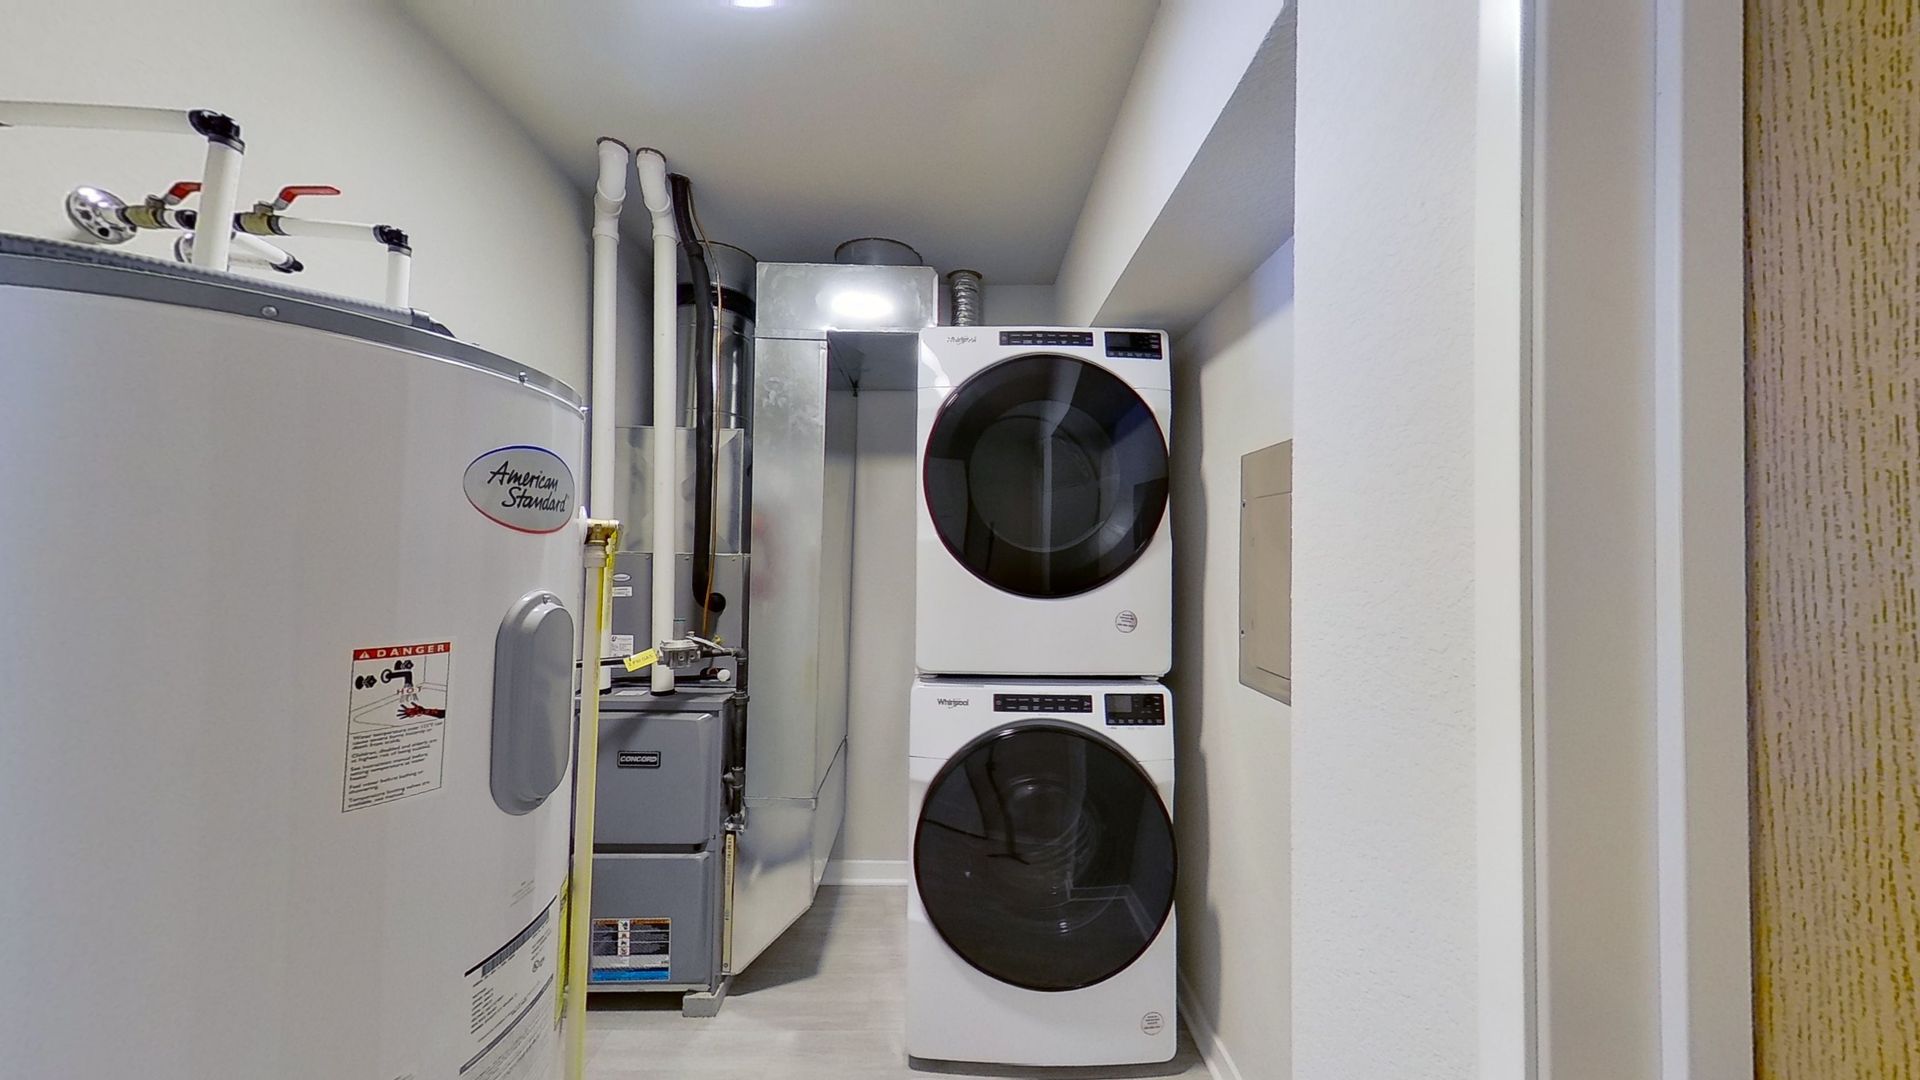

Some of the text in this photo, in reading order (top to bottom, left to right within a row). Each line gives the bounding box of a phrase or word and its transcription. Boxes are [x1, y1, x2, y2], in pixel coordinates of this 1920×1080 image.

[487, 460, 558, 491] American
[501, 486, 565, 512] Standard
[376, 644, 445, 658] DANGER
[396, 685, 423, 695] HOT
[936, 697, 969, 709] Whirlpool
[620, 755, 657, 763] CONCORD
